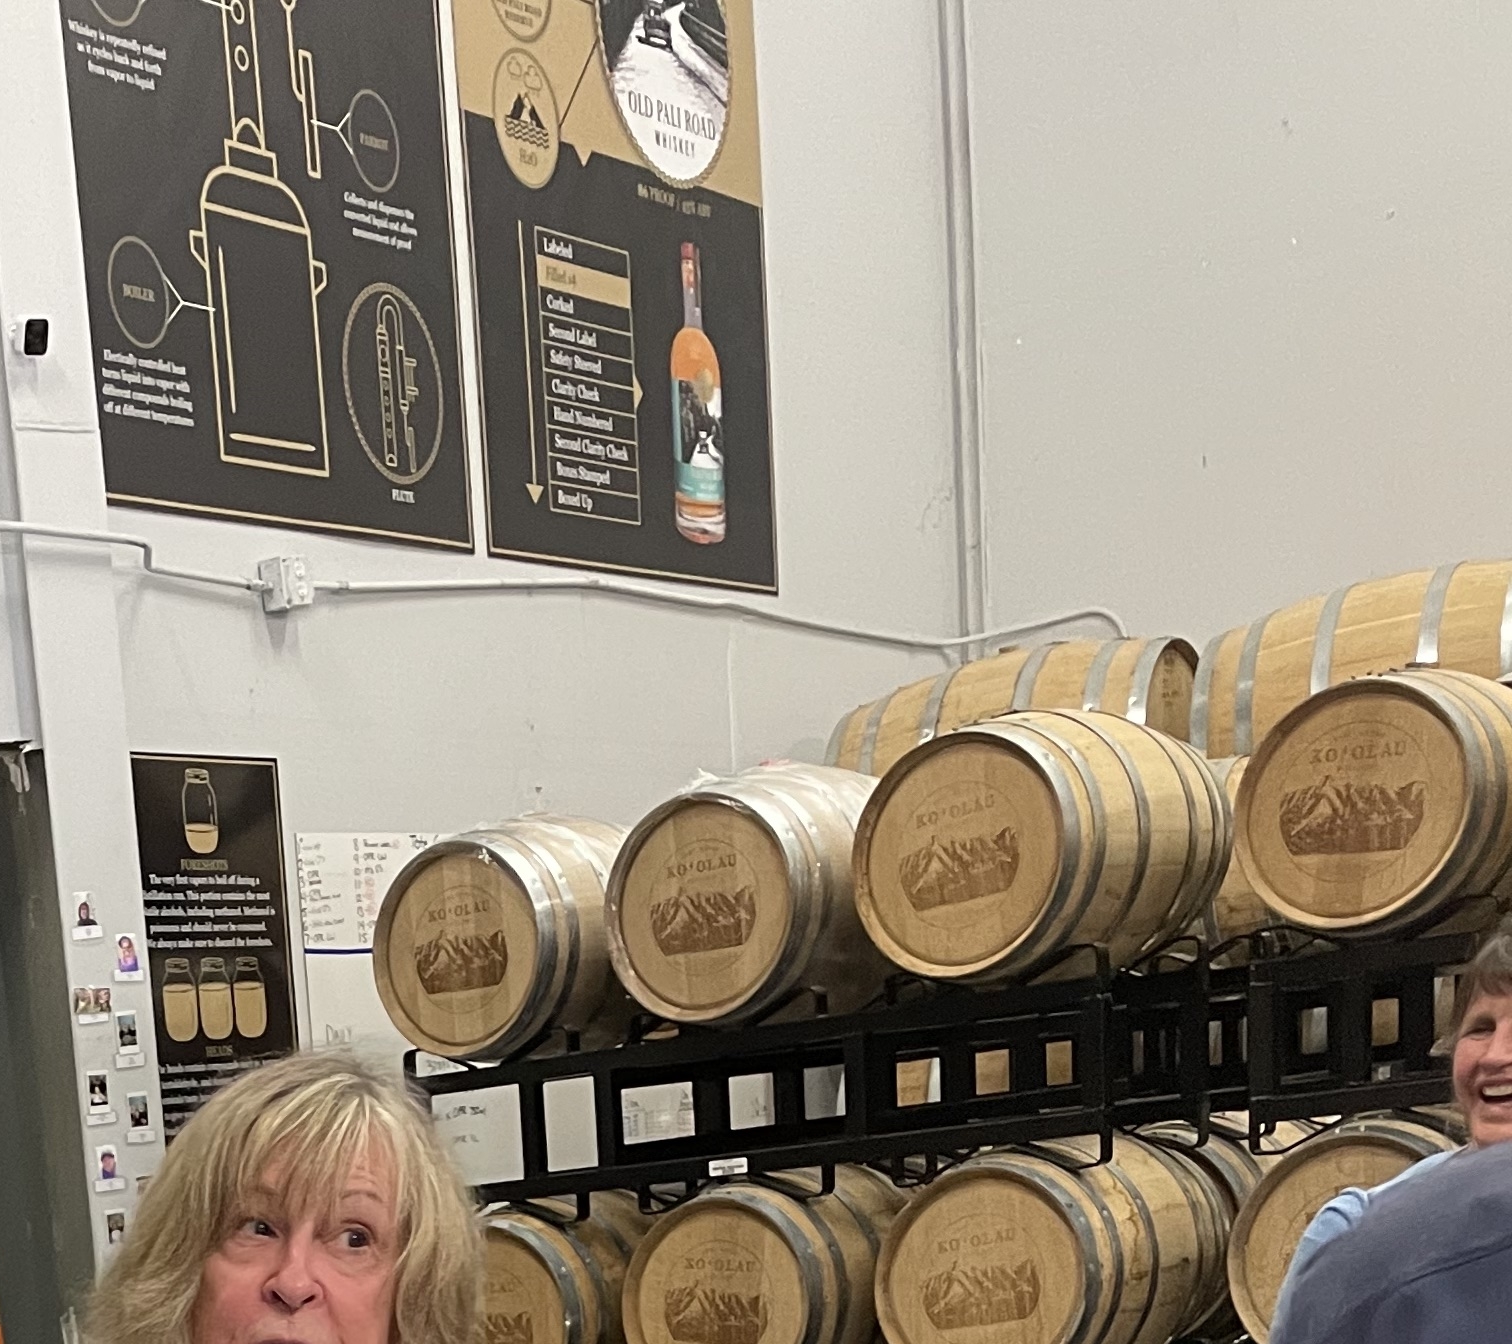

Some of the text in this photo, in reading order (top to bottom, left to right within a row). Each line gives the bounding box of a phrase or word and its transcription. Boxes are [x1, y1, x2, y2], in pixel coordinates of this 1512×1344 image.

[628, 90, 716, 141] OLD PALI ROAD
[654, 130, 695, 158] WHISKEY
